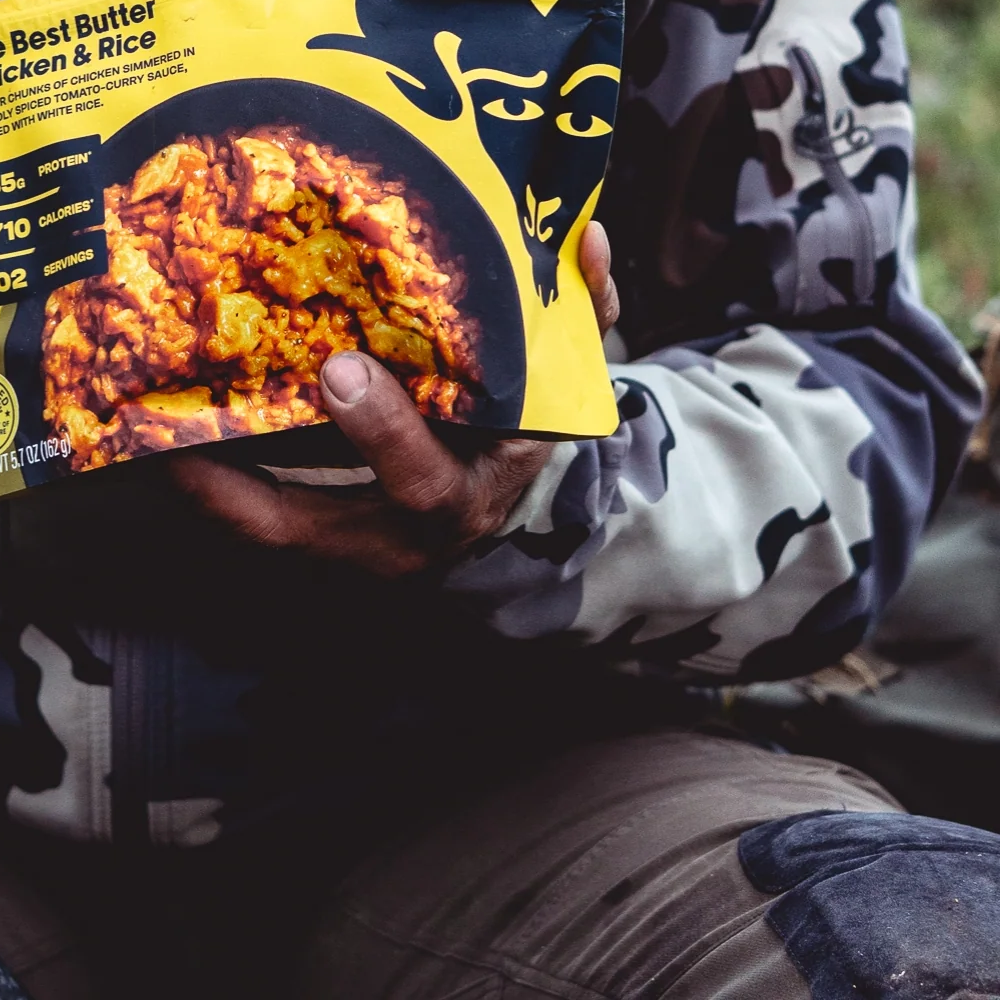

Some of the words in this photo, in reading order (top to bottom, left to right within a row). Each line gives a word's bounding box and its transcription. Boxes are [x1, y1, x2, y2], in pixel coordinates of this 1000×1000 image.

[9, 19, 71, 55] Best
[74, 0, 156, 40] Butter
[72, 43, 92, 67] &
[98, 30, 156, 60] Rice
[8, 84, 51, 104] CHUNKS
[53, 79, 69, 91] OF
[70, 67, 121, 86] CHICKEN
[122, 51, 182, 74] SIMMERED
[183, 46, 196, 57] IN
[15, 96, 52, 115] SPICED
[54, 74, 144, 104] TOMATO-CURRY
[147, 63, 189, 82] SAUCE,
[11, 115, 36, 132] WITH
[37, 106, 73, 122] WHITE
[74, 99, 105, 113] RICE.
[43, 248, 95, 277] SERVINGS
[2, 420, 10, 428] OF
[11, 447, 24, 470] 5.7
[25, 443, 41, 465] OZ
[39, 437, 60, 463] (162
[60, 432, 72, 459] g)
